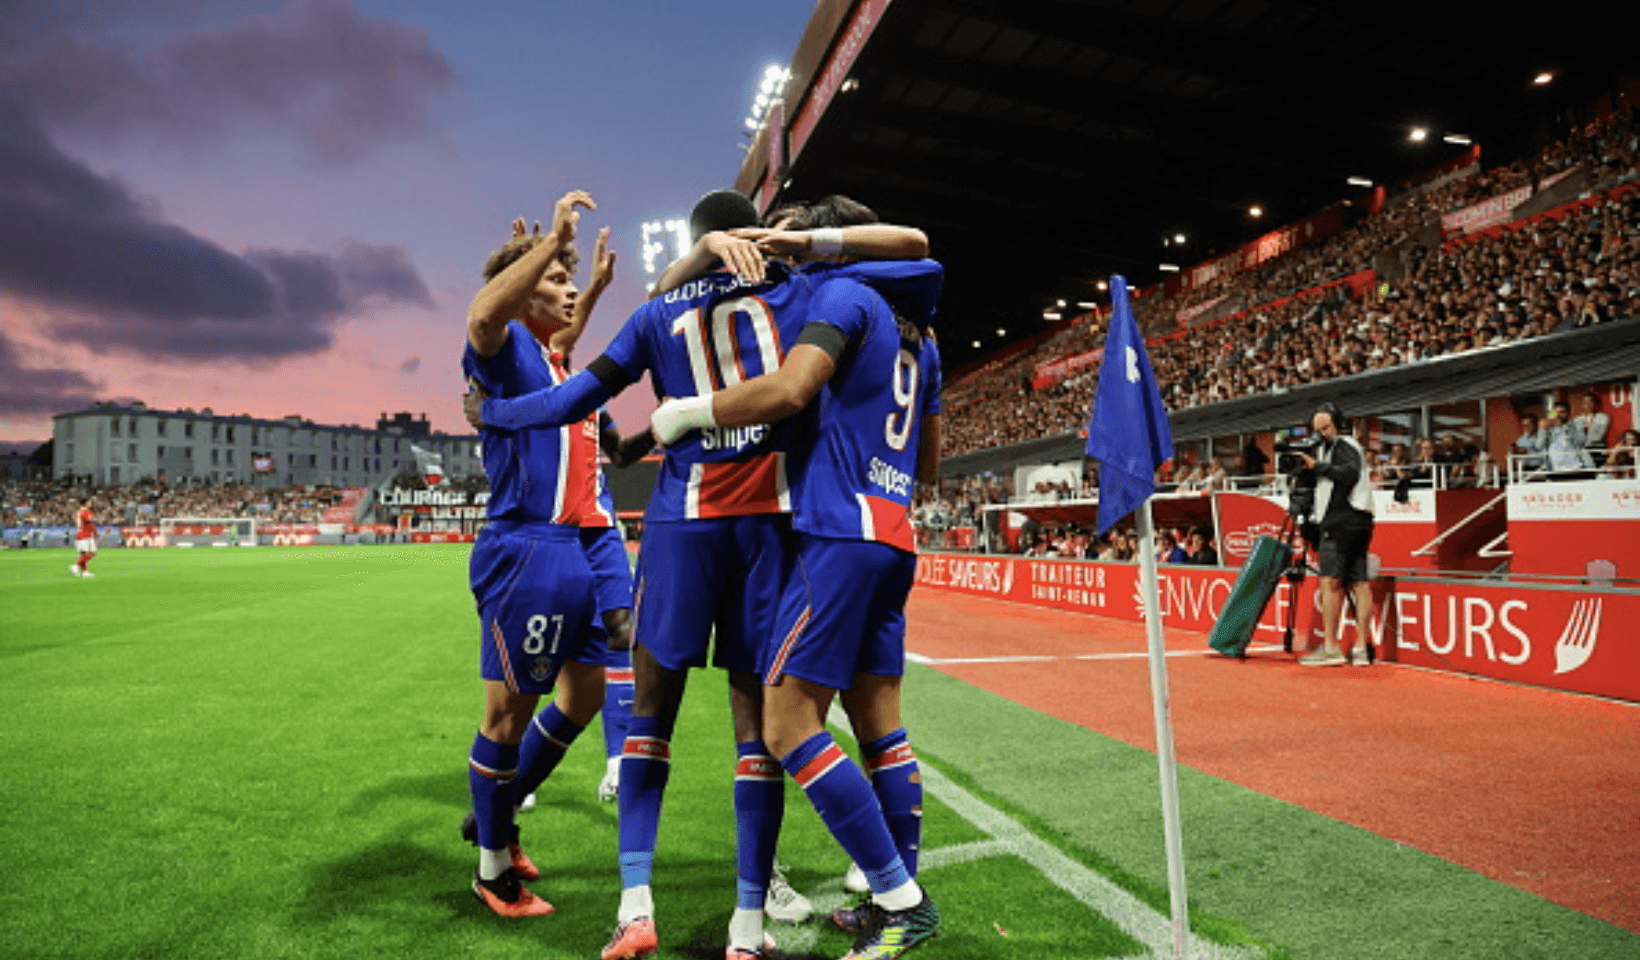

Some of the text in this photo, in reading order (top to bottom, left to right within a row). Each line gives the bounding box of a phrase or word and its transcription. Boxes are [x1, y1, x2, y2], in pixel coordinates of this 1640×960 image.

[671, 294, 785, 395] 10
[885, 348, 918, 451] 9
[1031, 562, 1106, 588] TRAITEUR
[522, 614, 564, 654] 87
